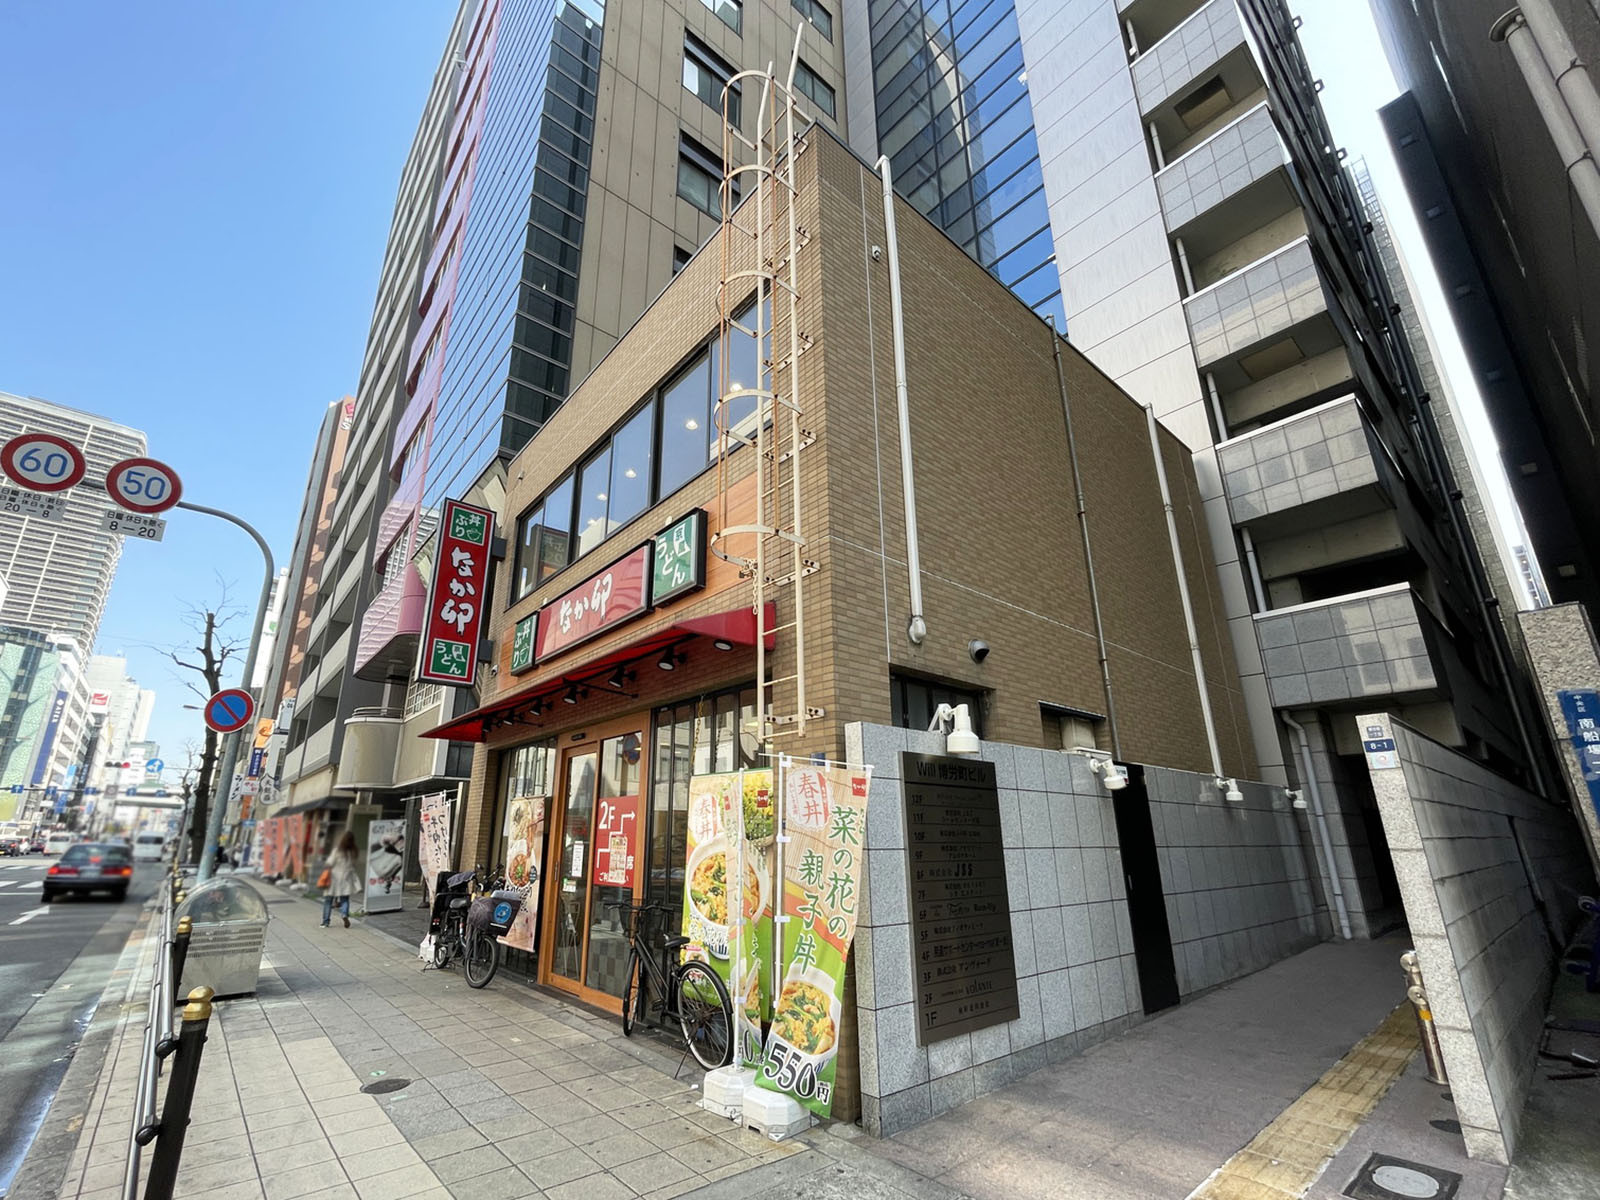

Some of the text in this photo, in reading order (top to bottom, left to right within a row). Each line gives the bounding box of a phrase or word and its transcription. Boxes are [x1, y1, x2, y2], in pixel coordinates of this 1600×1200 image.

[19, 448, 68, 478] 60
[123, 470, 166, 500] 50
[440, 546, 475, 636] なか卯
[559, 573, 613, 634] なか卯
[598, 800, 616, 830] 2F
[798, 772, 823, 826] 春丼
[824, 805, 859, 939] 菜の花の
[792, 848, 826, 975] 親子丼
[925, 1011, 938, 1027] 1F
